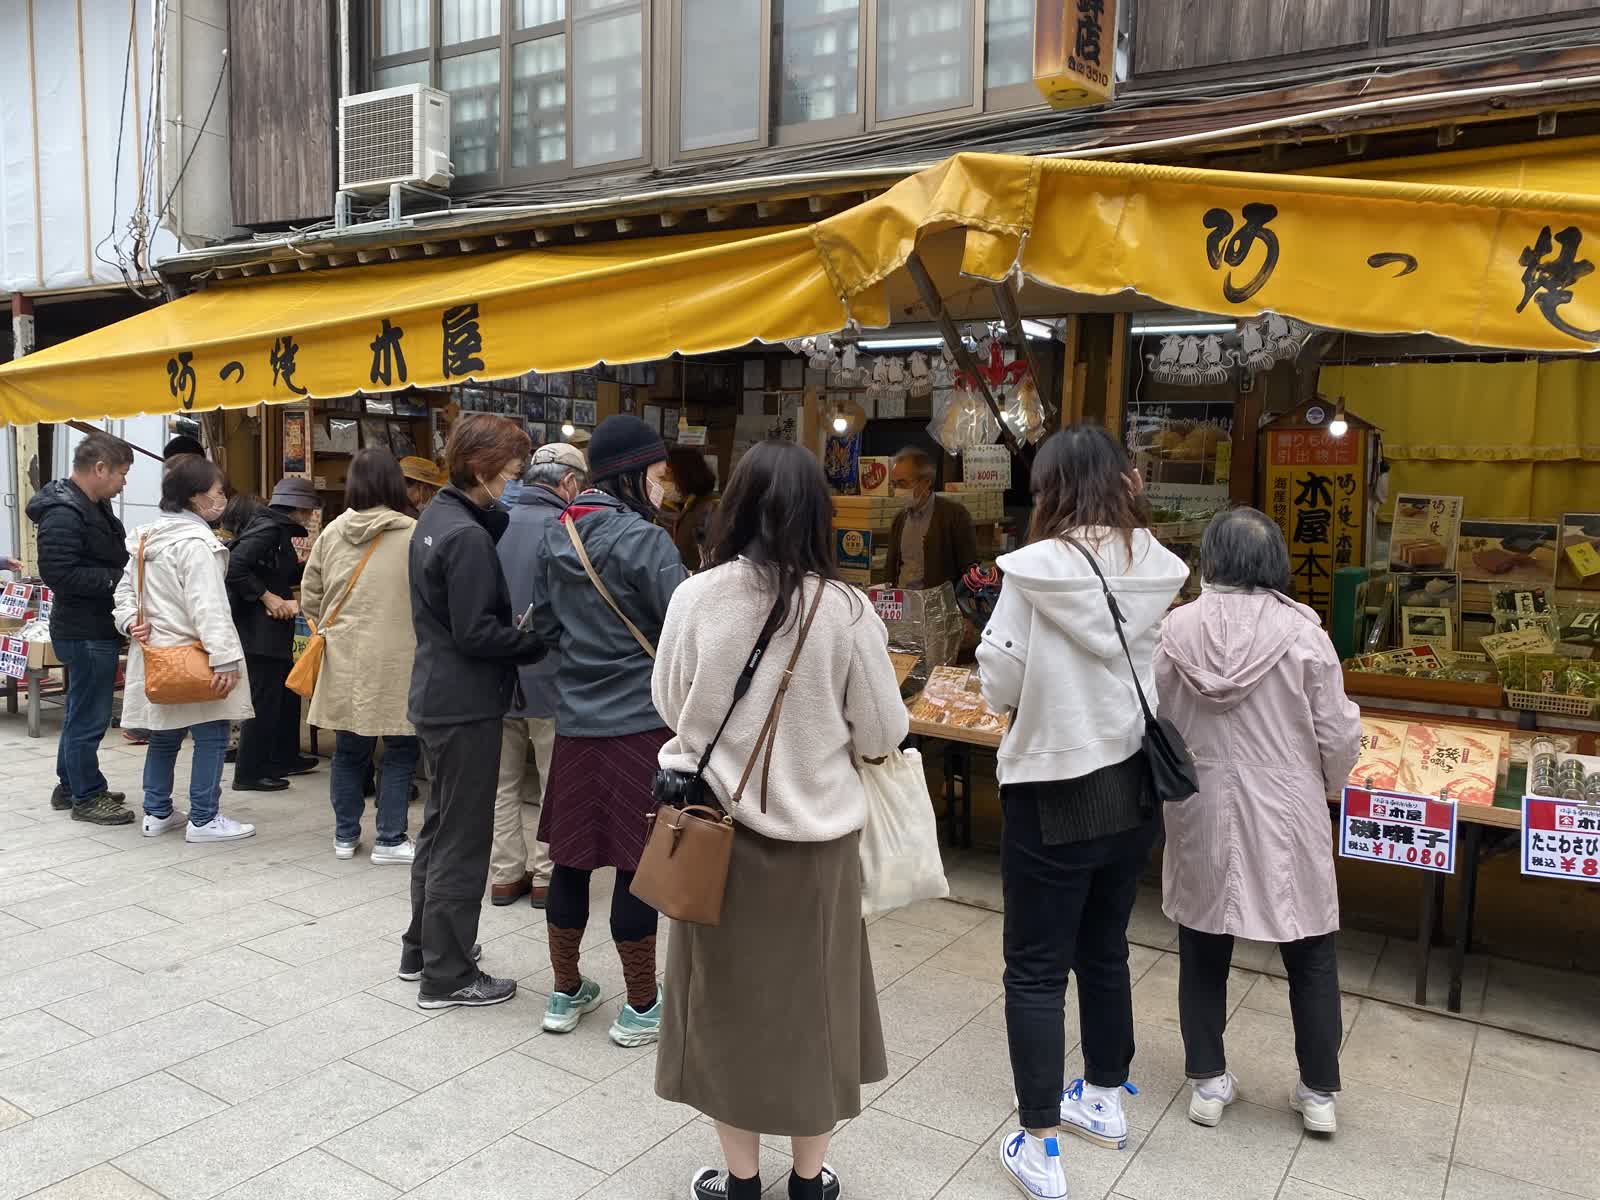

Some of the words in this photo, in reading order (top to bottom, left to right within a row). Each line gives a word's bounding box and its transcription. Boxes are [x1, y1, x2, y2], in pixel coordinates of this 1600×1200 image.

[370, 303, 485, 386] 木屋
[1389, 806, 1422, 822] 木屋
[1577, 817, 1600, 831] 木
[1348, 840, 1369, 852] 税込
[1532, 832, 1599, 856] たこわさび
[1531, 856, 1556, 868] 税込
